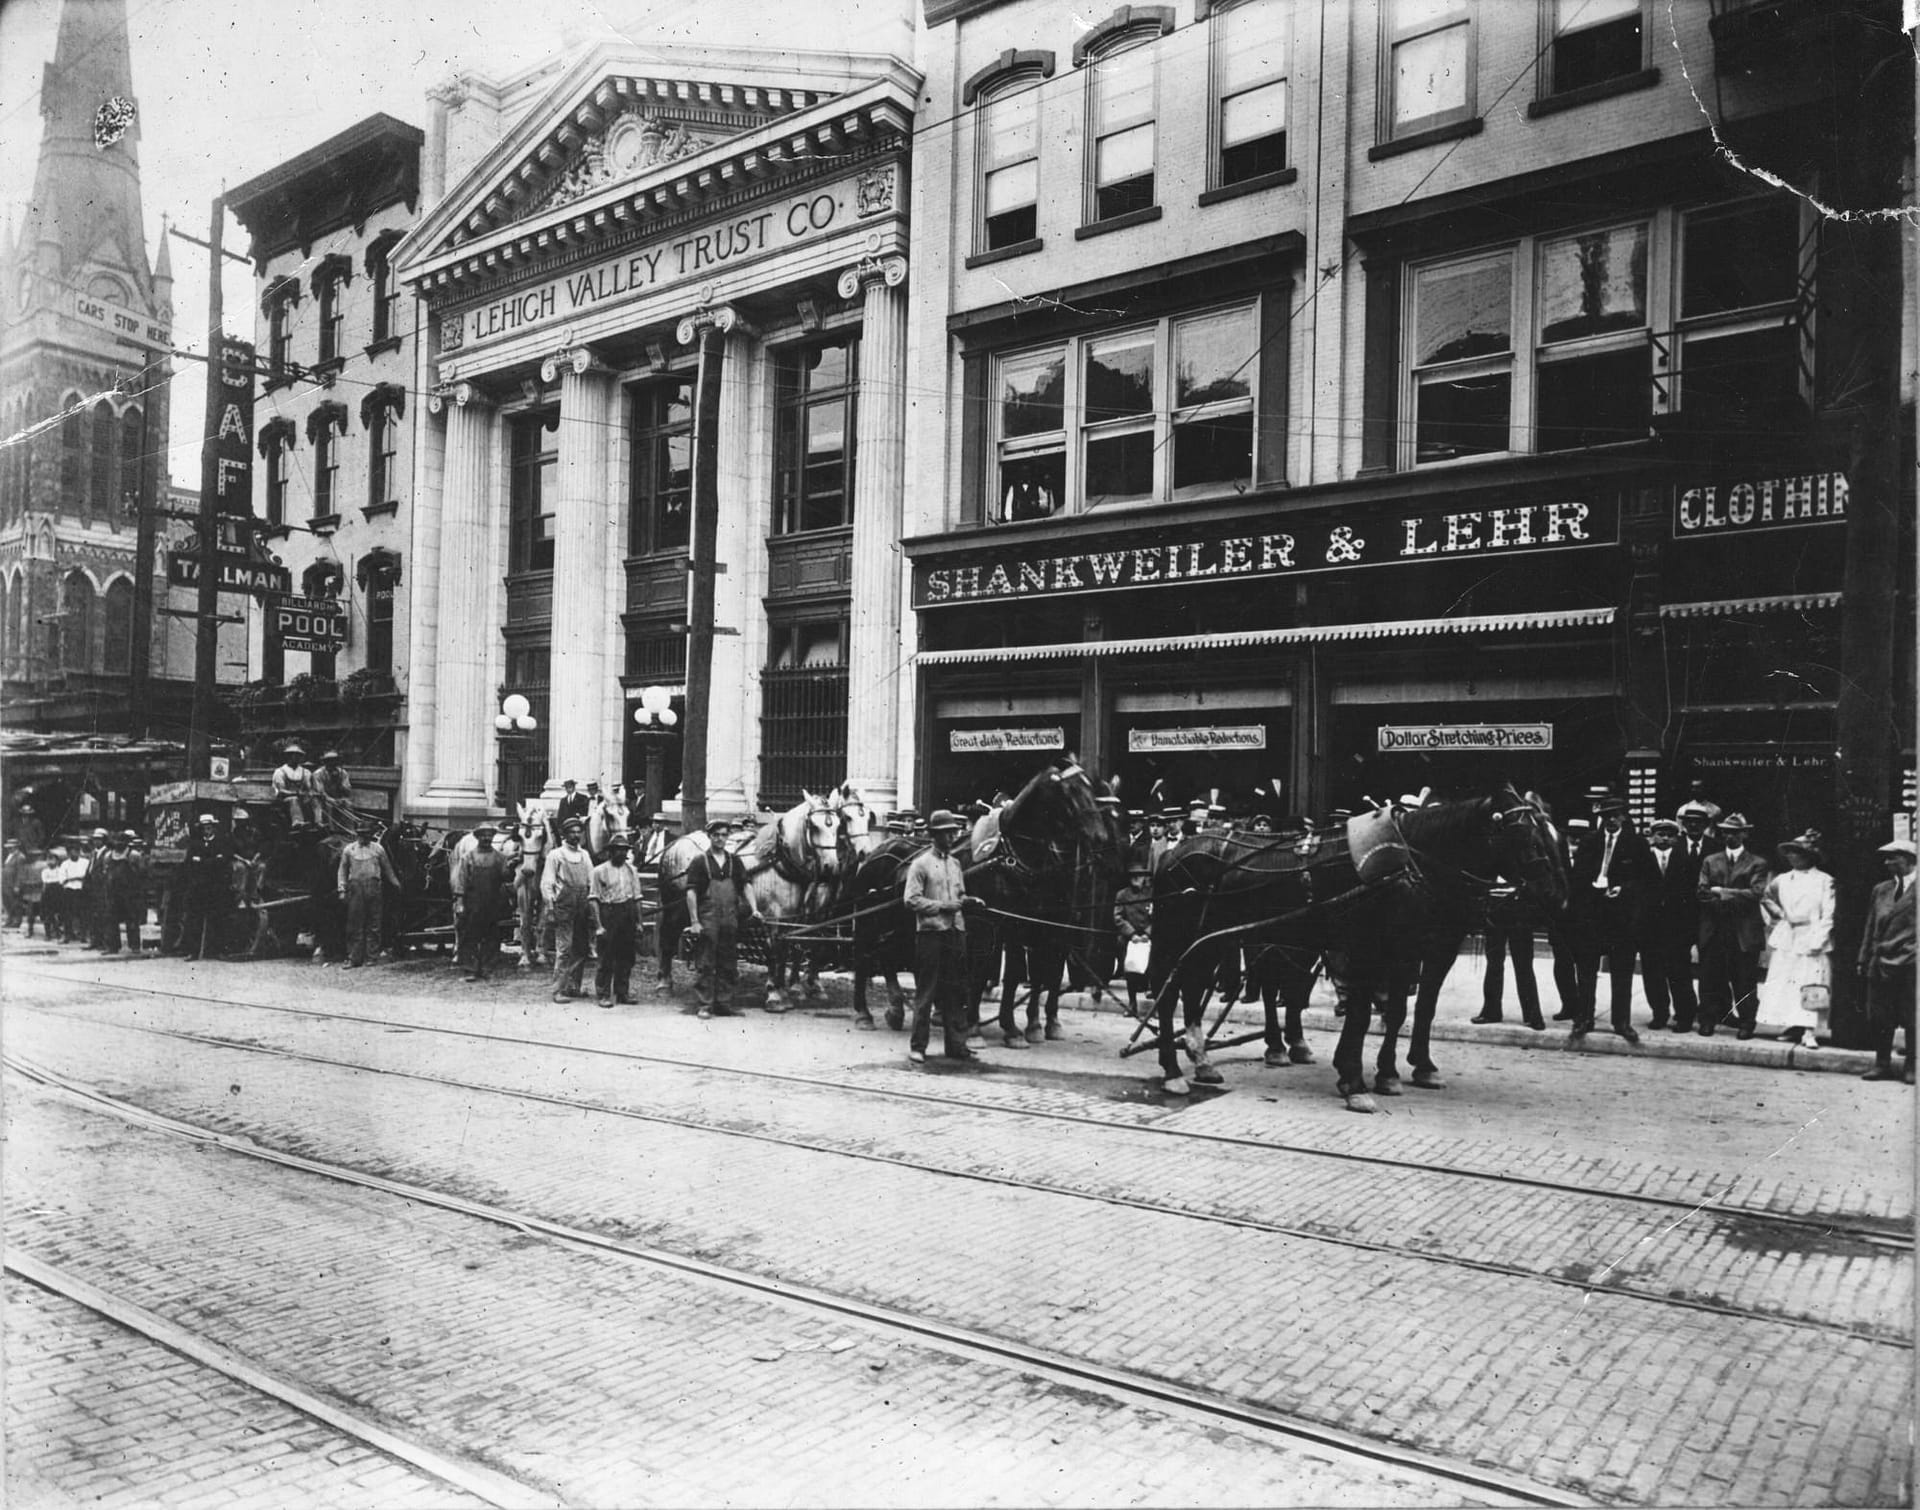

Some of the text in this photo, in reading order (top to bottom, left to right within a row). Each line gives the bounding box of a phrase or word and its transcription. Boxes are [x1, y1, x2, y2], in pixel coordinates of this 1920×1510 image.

[475, 285, 555, 339] LEHIGH
[566, 250, 663, 308] VALLEY
[673, 213, 773, 274] TRUST
[78, 300, 169, 346] CARS STOP HERE
[927, 503, 1590, 601] SHANKWEILER & LEHR
[177, 559, 282, 589] TALMAN
[278, 613, 343, 637] POOL
[281, 640, 334, 653] ACADEMY
[1385, 730, 1427, 747] Dollar
[1427, 728, 1495, 747] Stretching
[1792, 757, 1826, 767] Lehr
